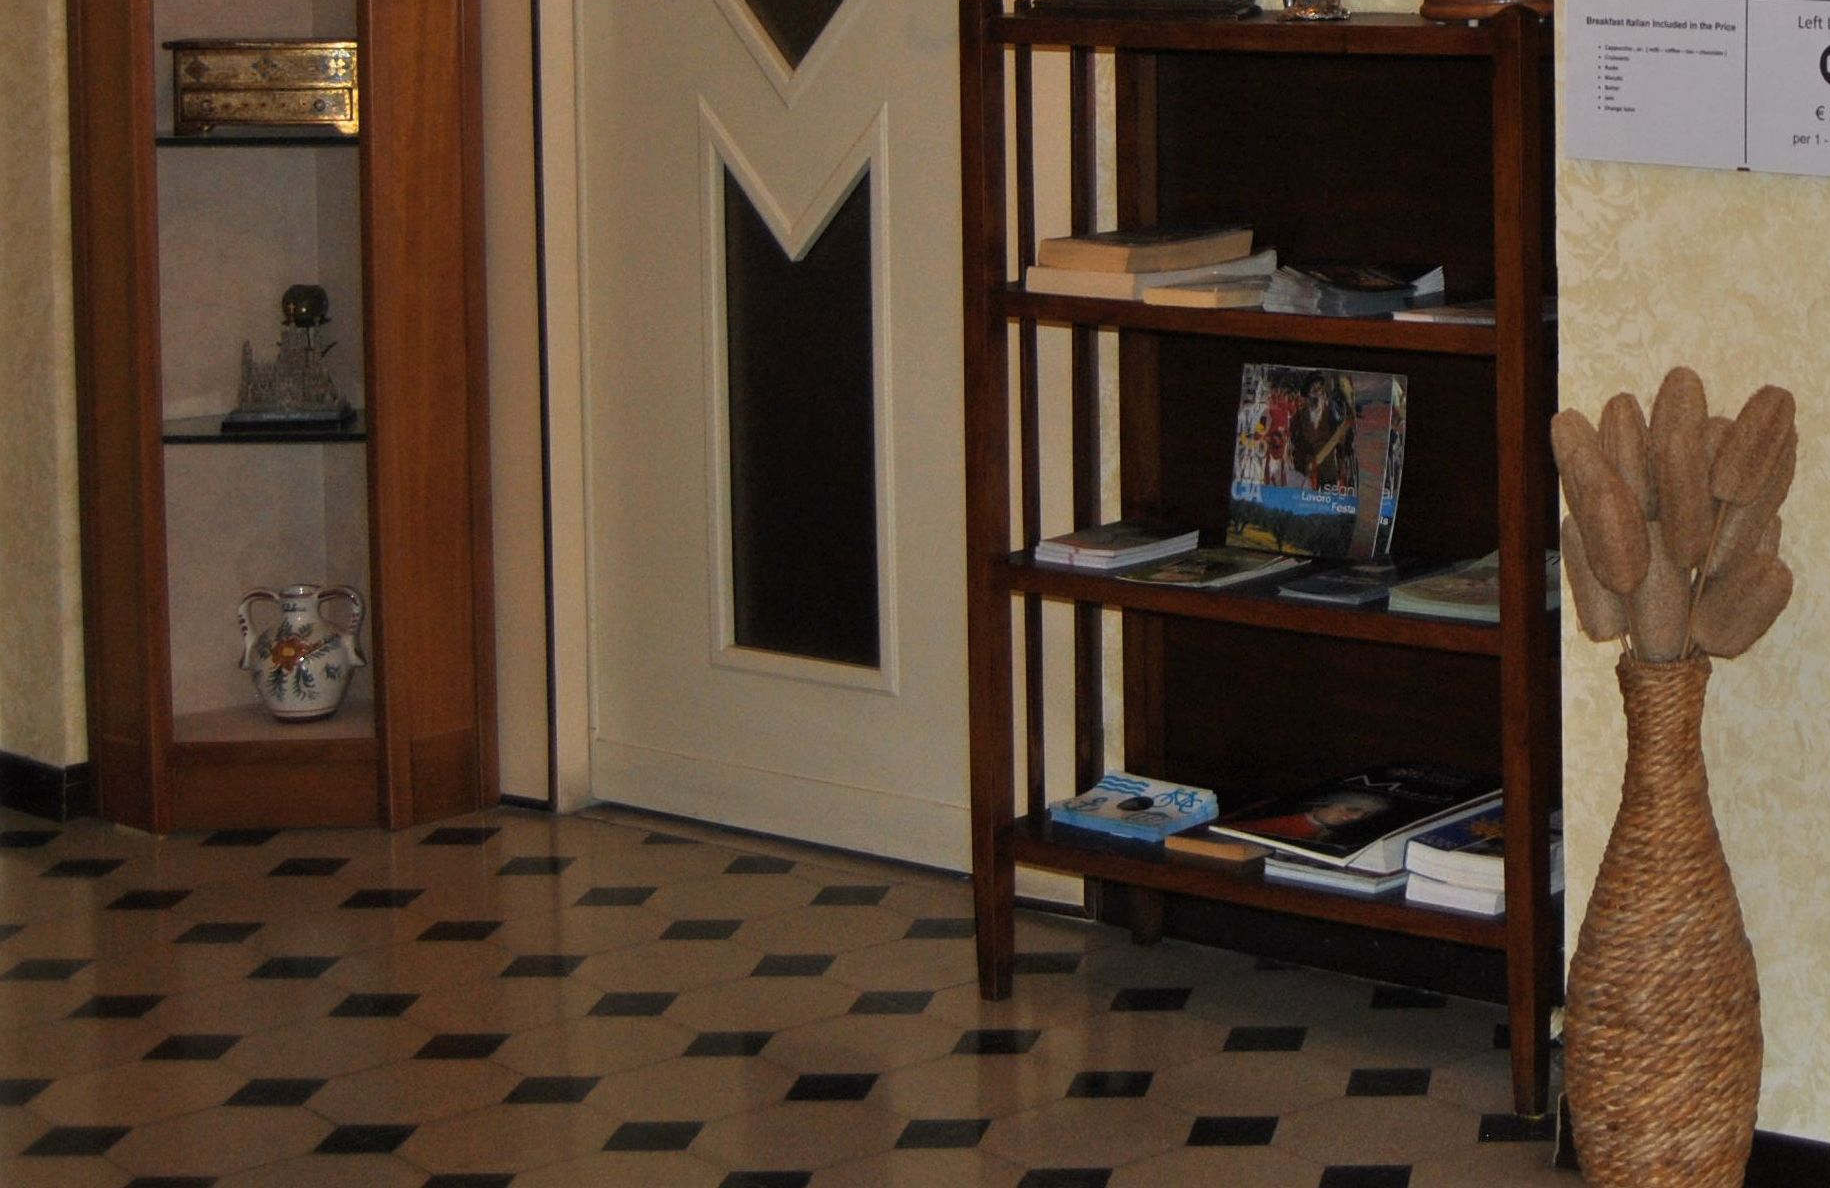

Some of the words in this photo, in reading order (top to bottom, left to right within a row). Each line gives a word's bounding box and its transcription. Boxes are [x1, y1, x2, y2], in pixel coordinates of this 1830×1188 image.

[1586, 16, 1624, 26] Breakfast
[1626, 18, 1650, 28] Italian
[1652, 19, 1687, 29] Included
[1689, 20, 1697, 30] in
[1699, 20, 1712, 30] the
[1714, 22, 1736, 32] Price
[1798, 15, 1823, 30] Left
[1815, 105, 1825, 121] €
[1793, 134, 1811, 146] per
[1301, 491, 1331, 503] Lavoro
[1331, 501, 1356, 514] Festa
